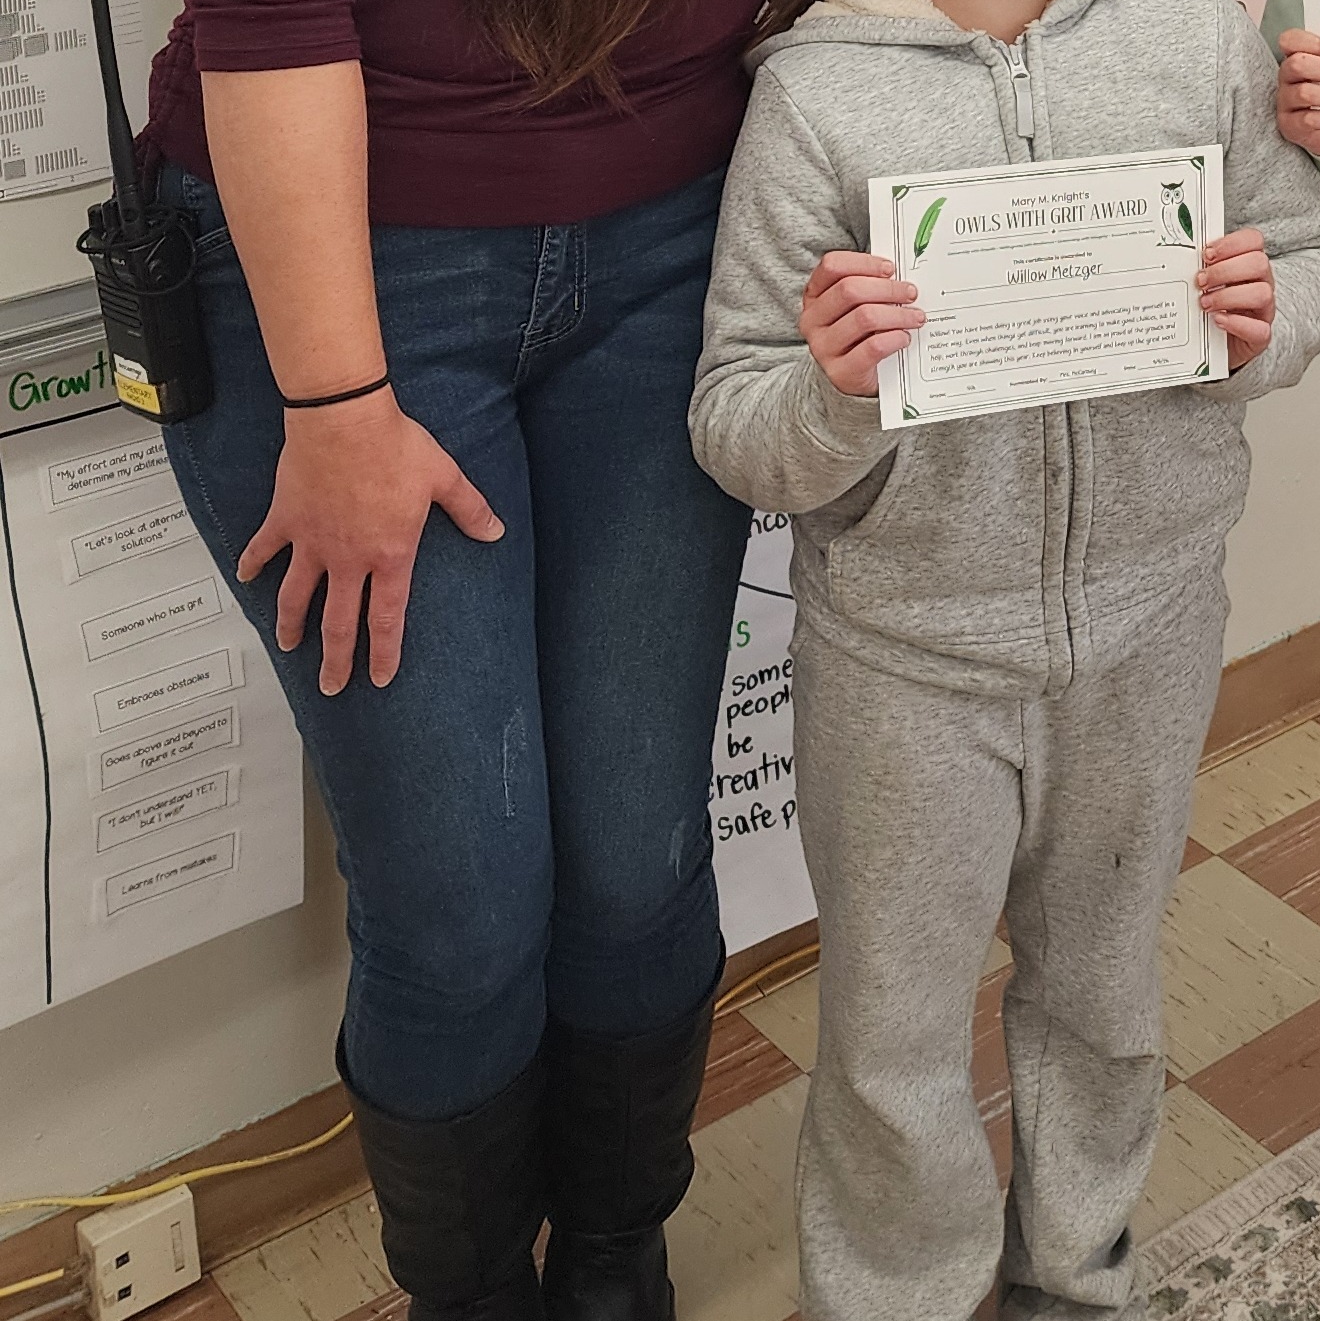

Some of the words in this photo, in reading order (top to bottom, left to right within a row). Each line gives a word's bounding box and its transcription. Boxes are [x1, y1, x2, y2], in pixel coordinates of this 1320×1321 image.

[1011, 196, 1036, 207] Mary
[1038, 195, 1049, 204] M.
[1051, 191, 1090, 204] Knight's
[955, 213, 1001, 236] OWLS
[1006, 209, 1046, 229] WITH
[1050, 204, 1085, 225] GRIT
[1090, 198, 1148, 220] AWARD
[1006, 268, 1048, 286] Willow
[1051, 263, 1103, 284] Metzger
[9, 350, 109, 411] Growt
[77, 460, 108, 476] effort
[109, 453, 127, 467] and
[129, 450, 144, 461] my
[146, 443, 166, 456] attit
[68, 472, 115, 491] determine
[117, 467, 132, 478] my
[115, 528, 135, 541] look
[136, 522, 148, 533] at
[101, 619, 145, 641] Someone
[146, 611, 167, 626] who
[168, 603, 185, 617] has
[117, 686, 164, 710] Embraces
[167, 671, 210, 692] obstacles
[732, 658, 793, 696] some
[726, 684, 790, 728] peopl
[105, 752, 130, 768] Goes
[132, 742, 162, 758] above
[164, 733, 181, 747] and
[182, 723, 216, 740] beyond
[217, 718, 227, 727] to
[727, 733, 753, 758] be
[143, 790, 193, 815] understand
[717, 802, 777, 842] safe
[121, 877, 154, 895] Learns
[155, 868, 178, 884] from
